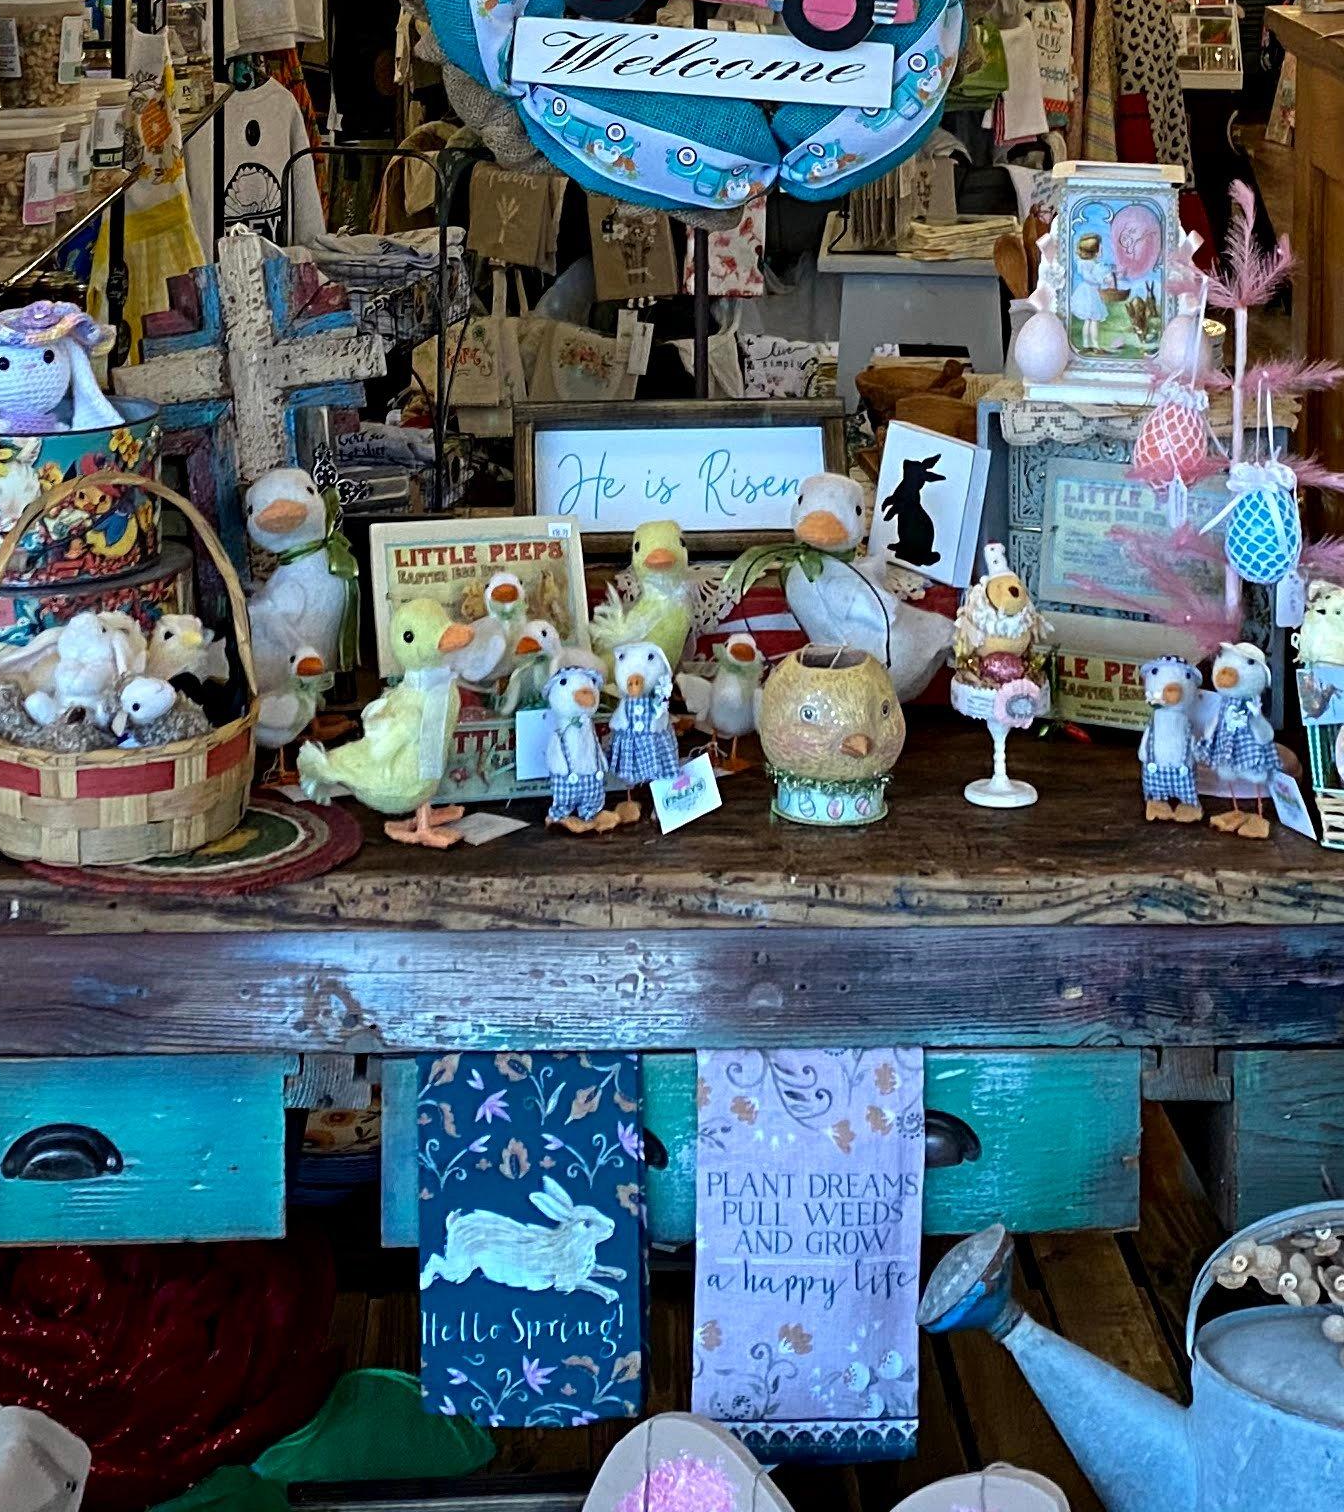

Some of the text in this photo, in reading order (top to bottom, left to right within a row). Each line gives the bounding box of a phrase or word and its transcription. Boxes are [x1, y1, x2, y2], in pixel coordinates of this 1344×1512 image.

[542, 31, 866, 84] Welcome
[557, 448, 799, 519] He is Risen
[394, 539, 564, 568] LITTLE PEEPS
[397, 569, 448, 585] EASTER
[453, 728, 516, 753] TTL
[708, 1172, 919, 1199] PLANT DREAMS
[722, 1200, 904, 1226] PULL WEEDS
[734, 1228, 891, 1255] AND GROW
[707, 1258, 918, 1310] a happy life
[420, 1303, 624, 1359] Hello Spring!
